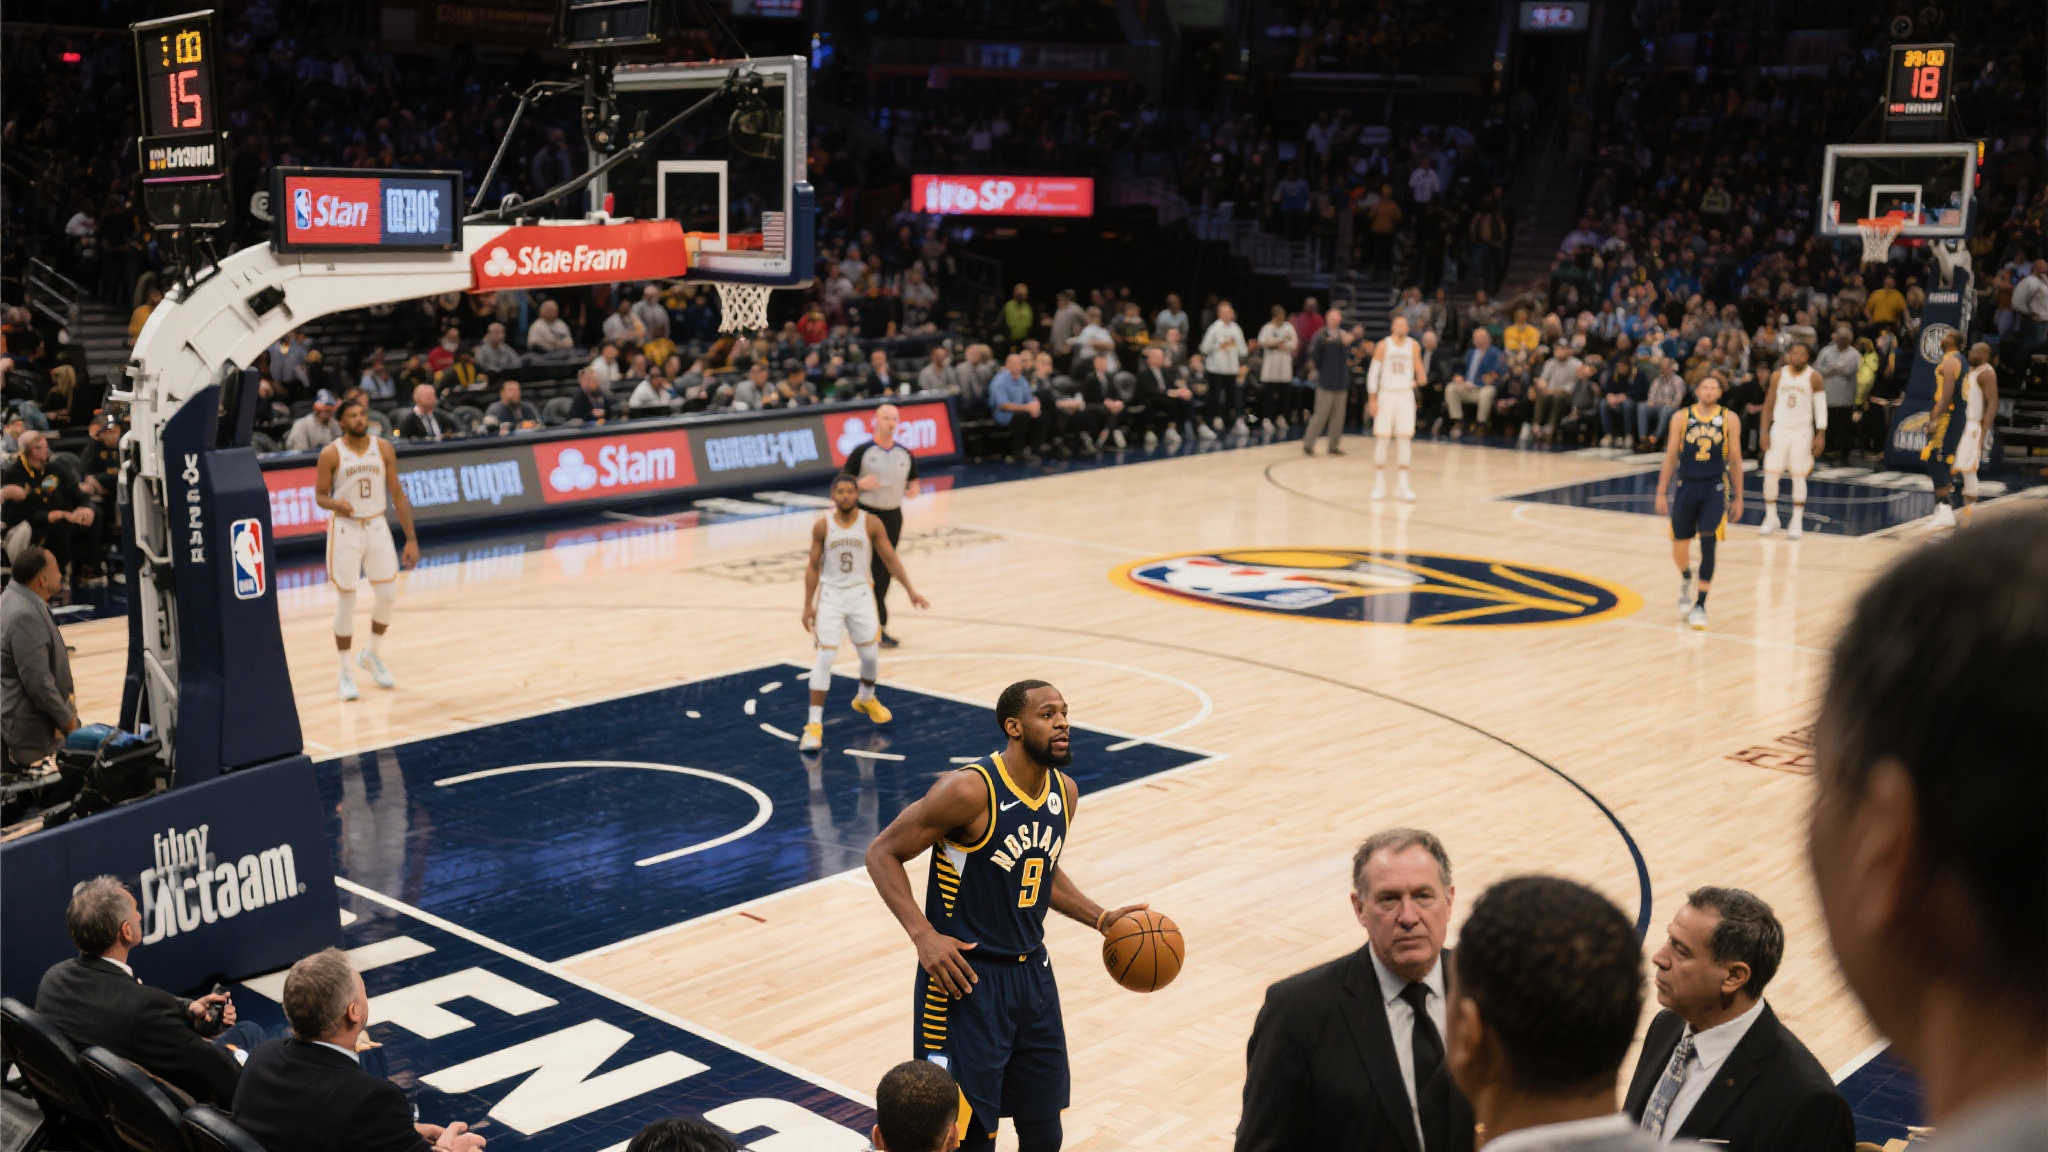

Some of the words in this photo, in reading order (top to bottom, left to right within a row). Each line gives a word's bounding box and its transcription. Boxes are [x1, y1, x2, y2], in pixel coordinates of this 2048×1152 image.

[169, 69, 202, 128] 15
[1911, 67, 1940, 98] 18
[598, 444, 676, 488] Stam
[1018, 857, 1044, 908] 9
